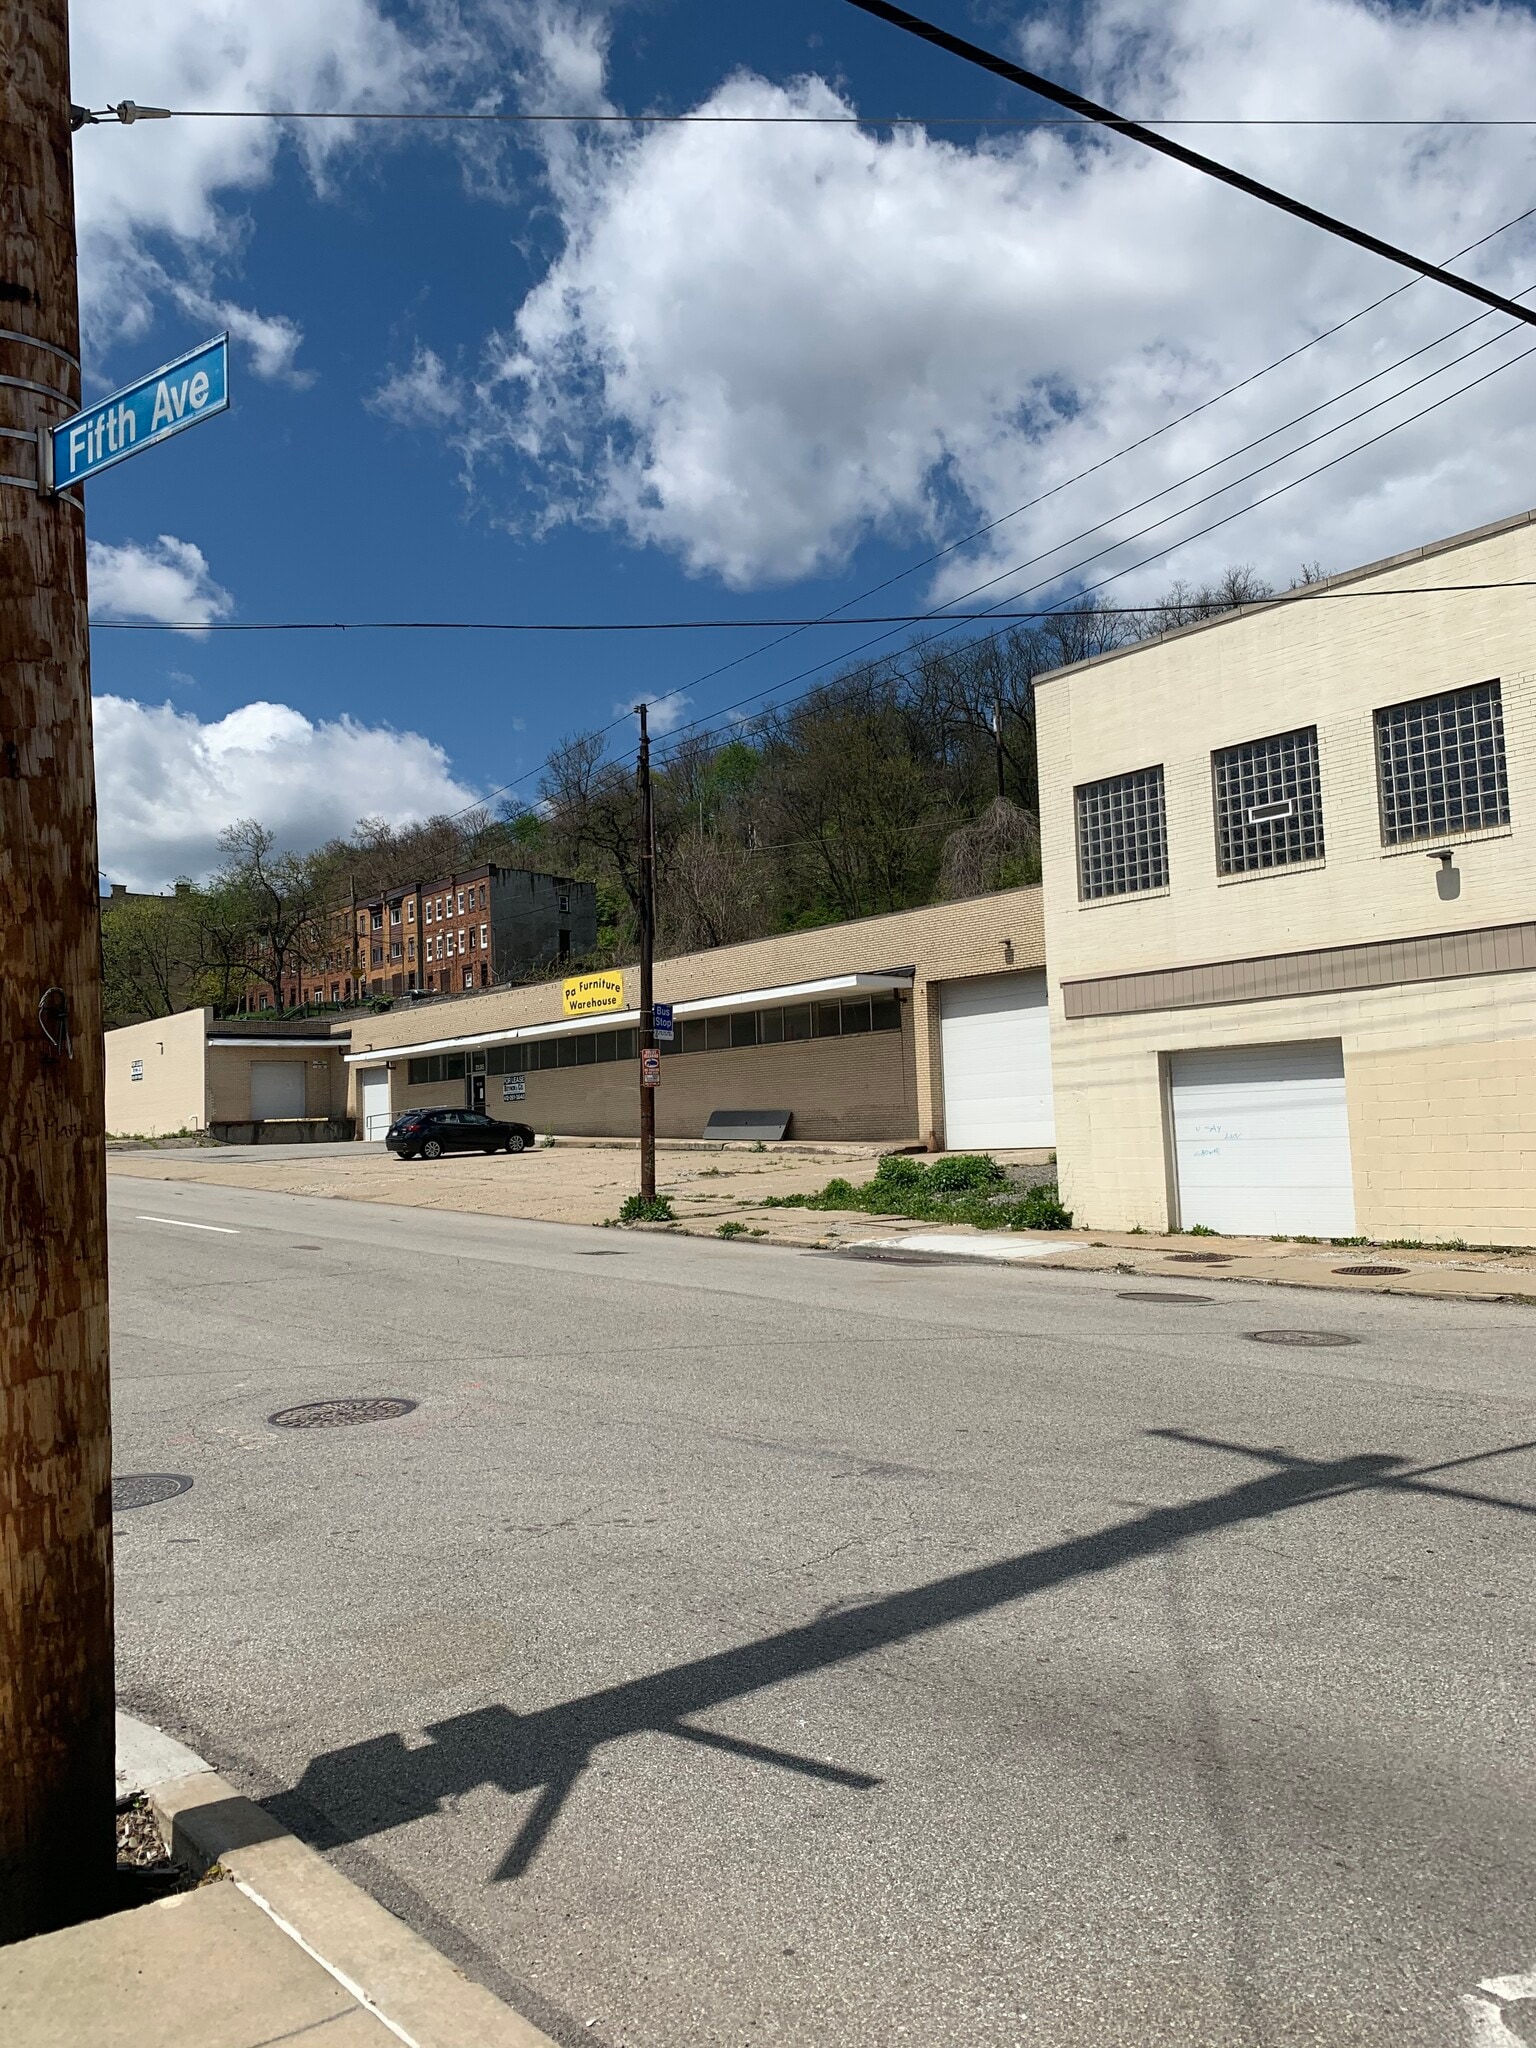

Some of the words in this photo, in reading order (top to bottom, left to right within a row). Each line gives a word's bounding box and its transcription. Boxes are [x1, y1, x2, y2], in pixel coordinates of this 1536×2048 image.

[69, 402, 136, 473] Fifth
[150, 371, 210, 432] Ave
[579, 977, 621, 993] Furniture
[569, 997, 617, 1010] Warehouse
[656, 1006, 671, 1016] Bus
[655, 1017, 672, 1028] Stop
[511, 1075, 525, 1083] LEASE
